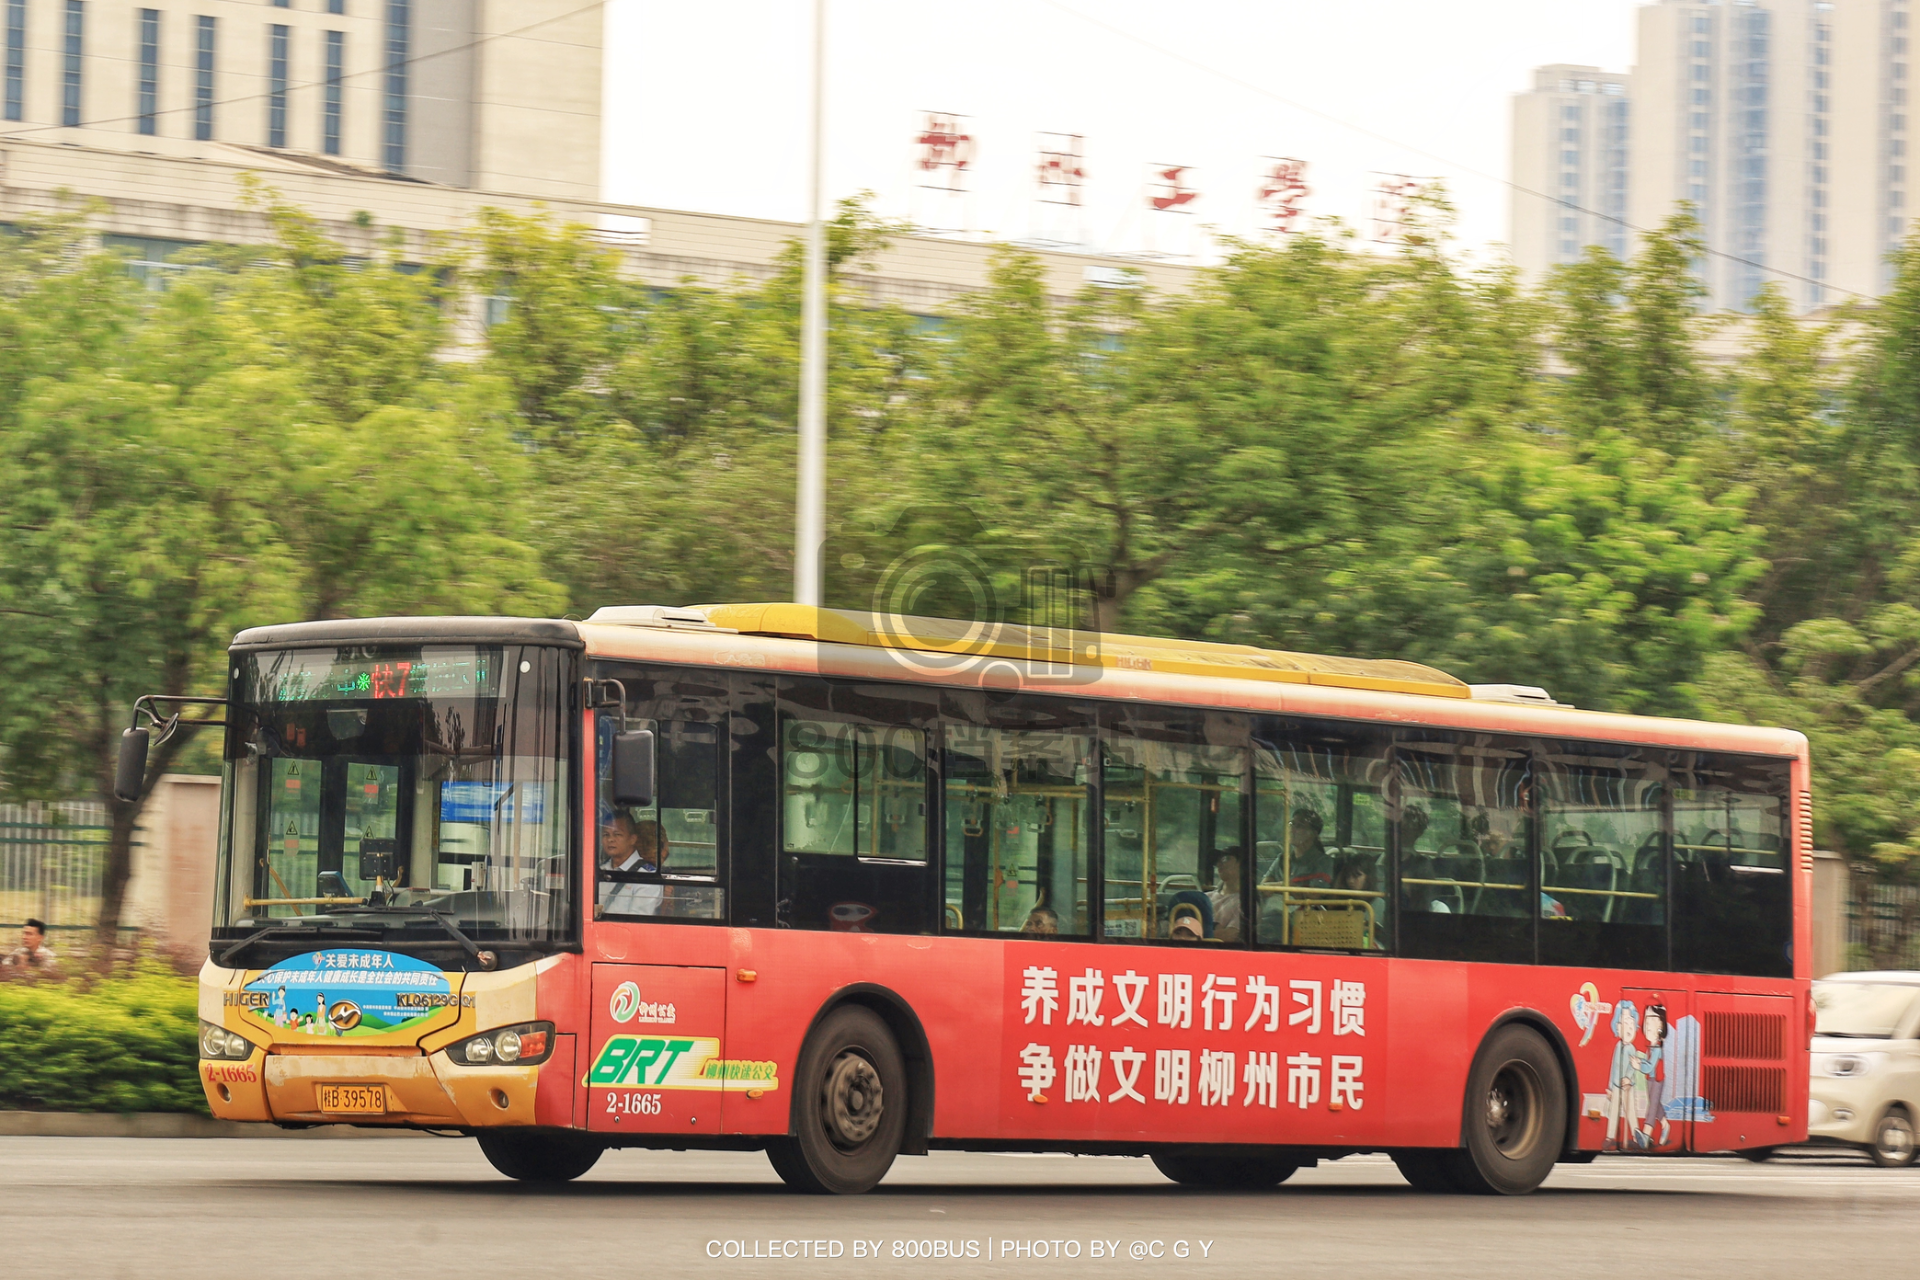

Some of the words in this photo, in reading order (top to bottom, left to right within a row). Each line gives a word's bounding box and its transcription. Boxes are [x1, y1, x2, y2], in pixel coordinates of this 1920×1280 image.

[325, 953, 394, 969] 关爱未成年人
[223, 990, 271, 1008] HIGER
[1020, 965, 1367, 1037] 养成文明行为习惯
[584, 1037, 695, 1085] BRT
[207, 1063, 257, 1083] 2-1665
[1017, 1042, 1365, 1111] 争做文明柳州市民
[606, 1092, 662, 1115] 2-1665
